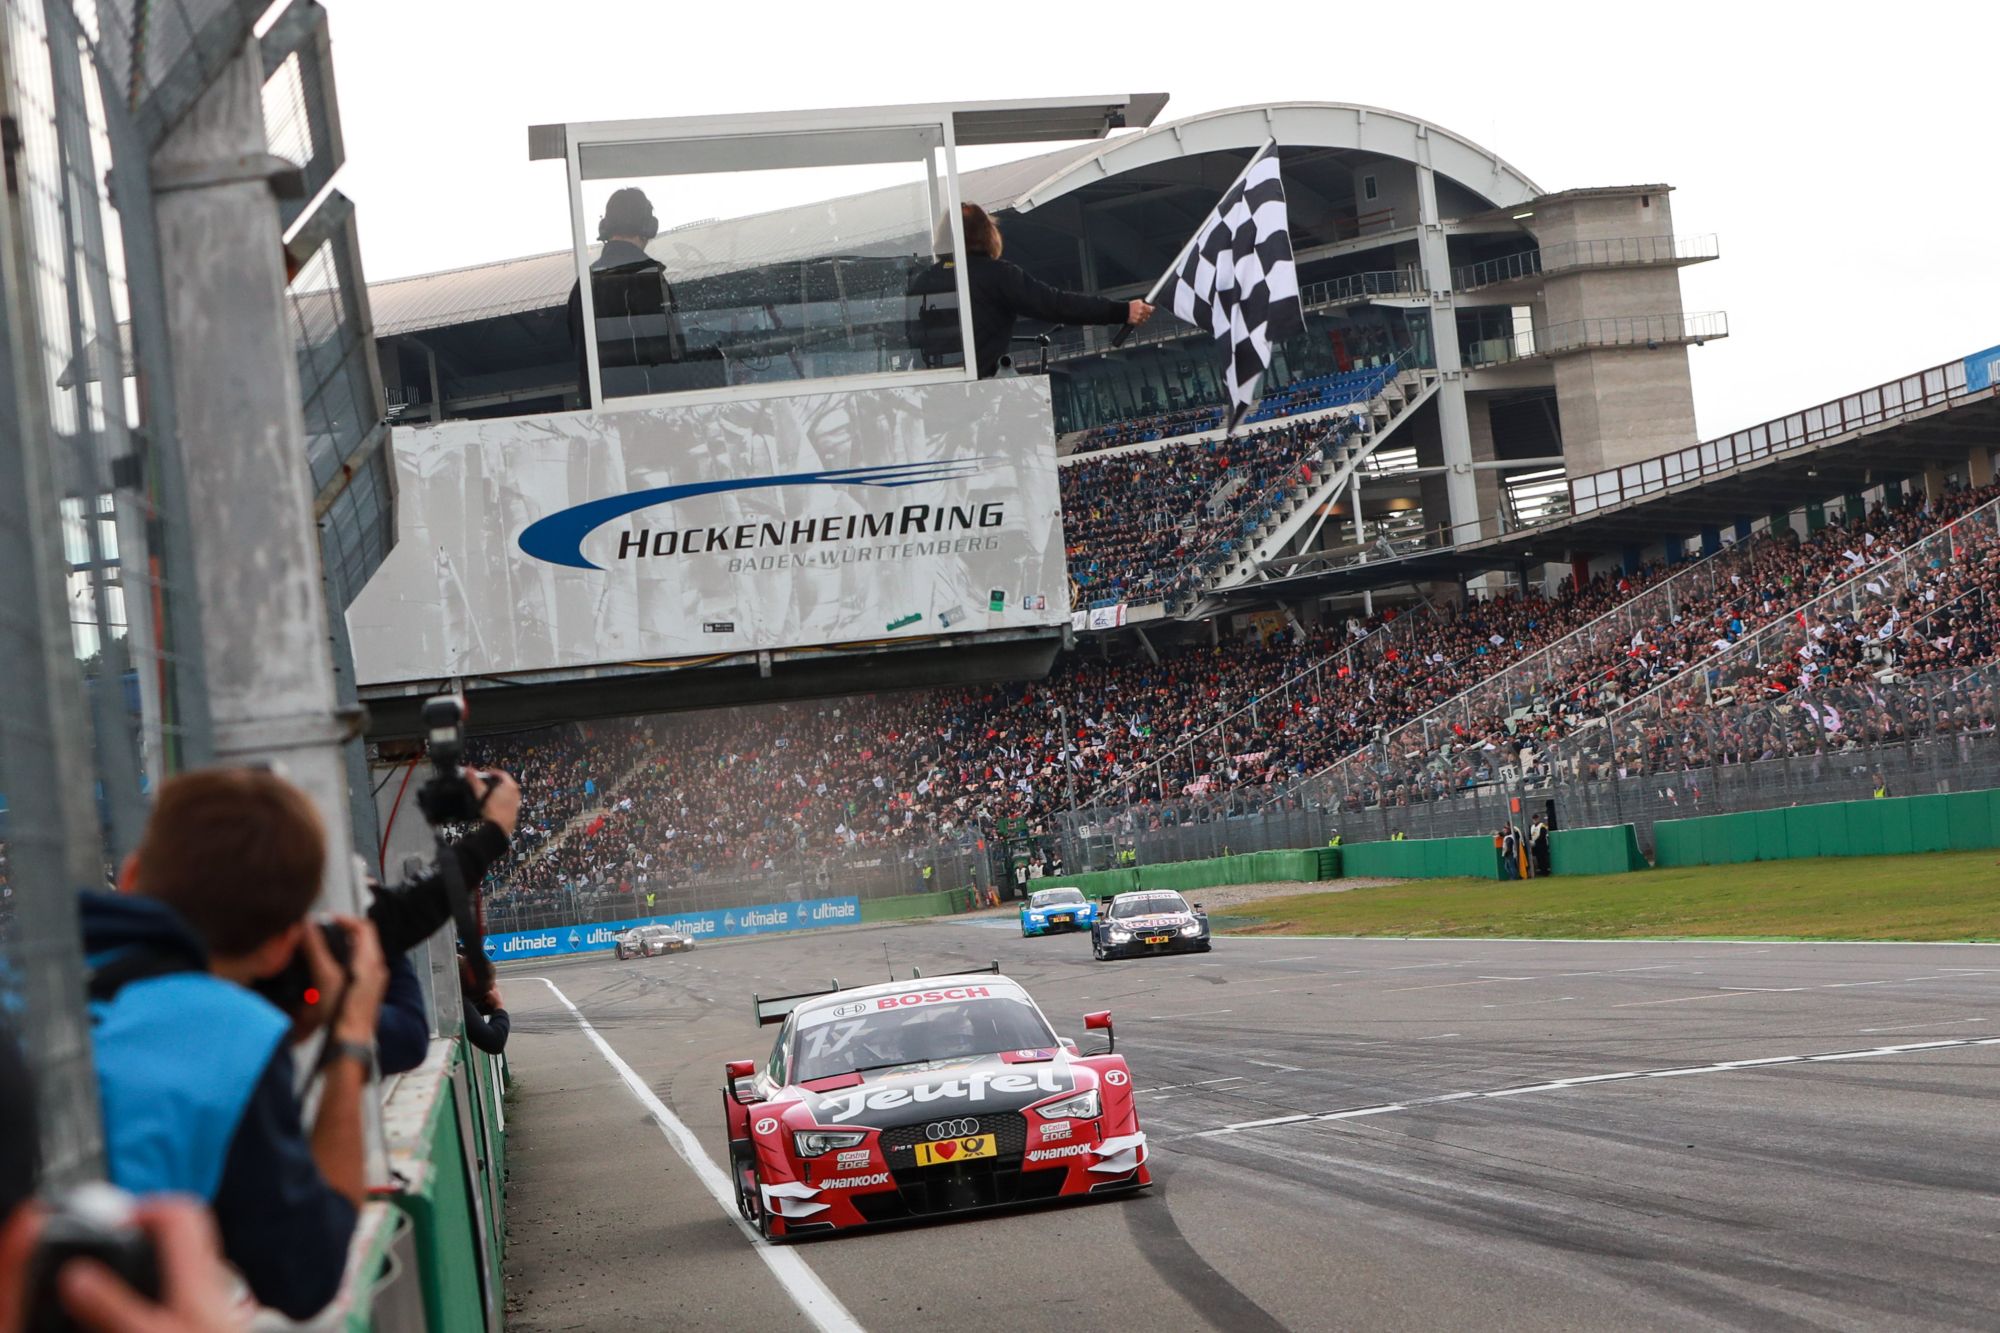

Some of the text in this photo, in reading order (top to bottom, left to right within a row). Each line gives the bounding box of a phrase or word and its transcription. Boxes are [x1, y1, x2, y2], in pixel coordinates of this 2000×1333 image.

[728, 535, 999, 573] BADEN-WÜRTTEMBERG
[741, 909, 788, 927] ultimate
[813, 901, 855, 919] ultimate
[503, 933, 557, 953] ultimate
[877, 987, 990, 1010] BOSCH
[805, 1019, 867, 1060] 17
[818, 1068, 1062, 1123] Teufel
[1042, 1130, 1073, 1142] EDGE
[836, 1159, 870, 1171] EDGE
[844, 1151, 868, 1160] Castrol
